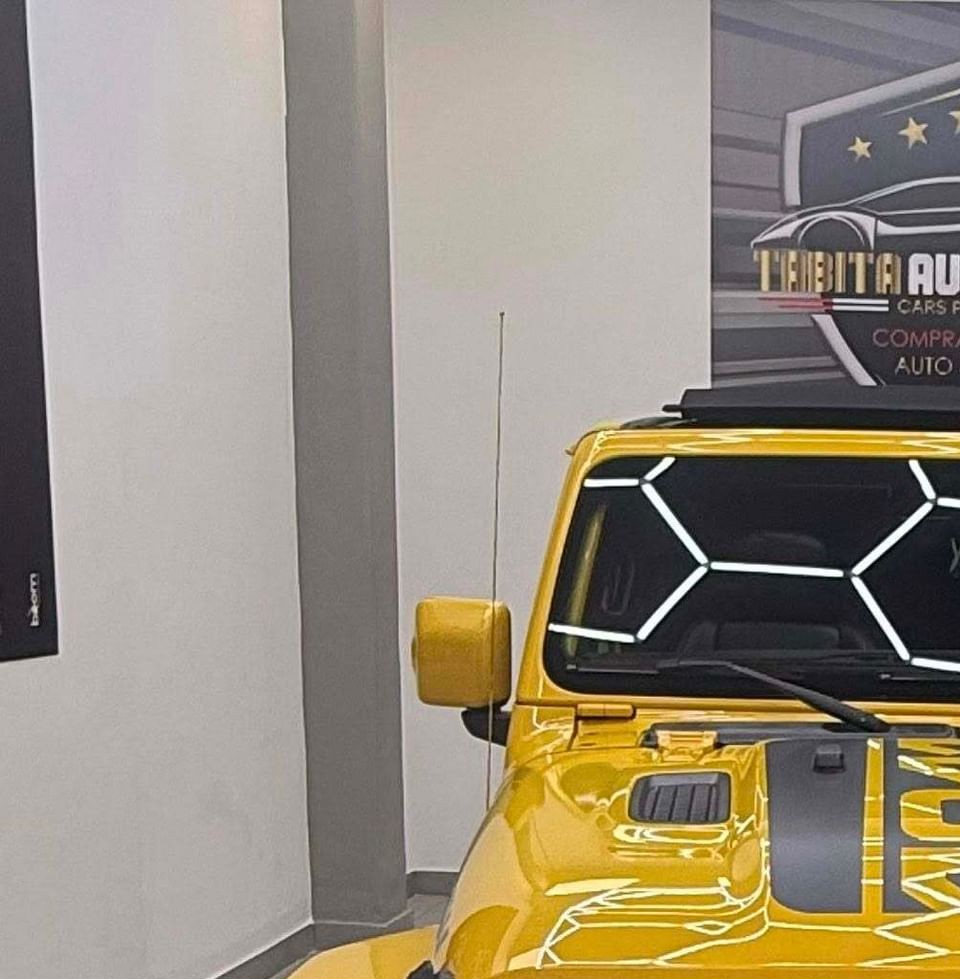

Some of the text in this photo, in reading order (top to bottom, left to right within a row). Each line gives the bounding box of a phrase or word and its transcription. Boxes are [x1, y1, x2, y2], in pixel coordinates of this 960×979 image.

[753, 249, 901, 295] TABITA
[897, 298, 947, 316] CARS
[895, 356, 953, 376] AUTO
